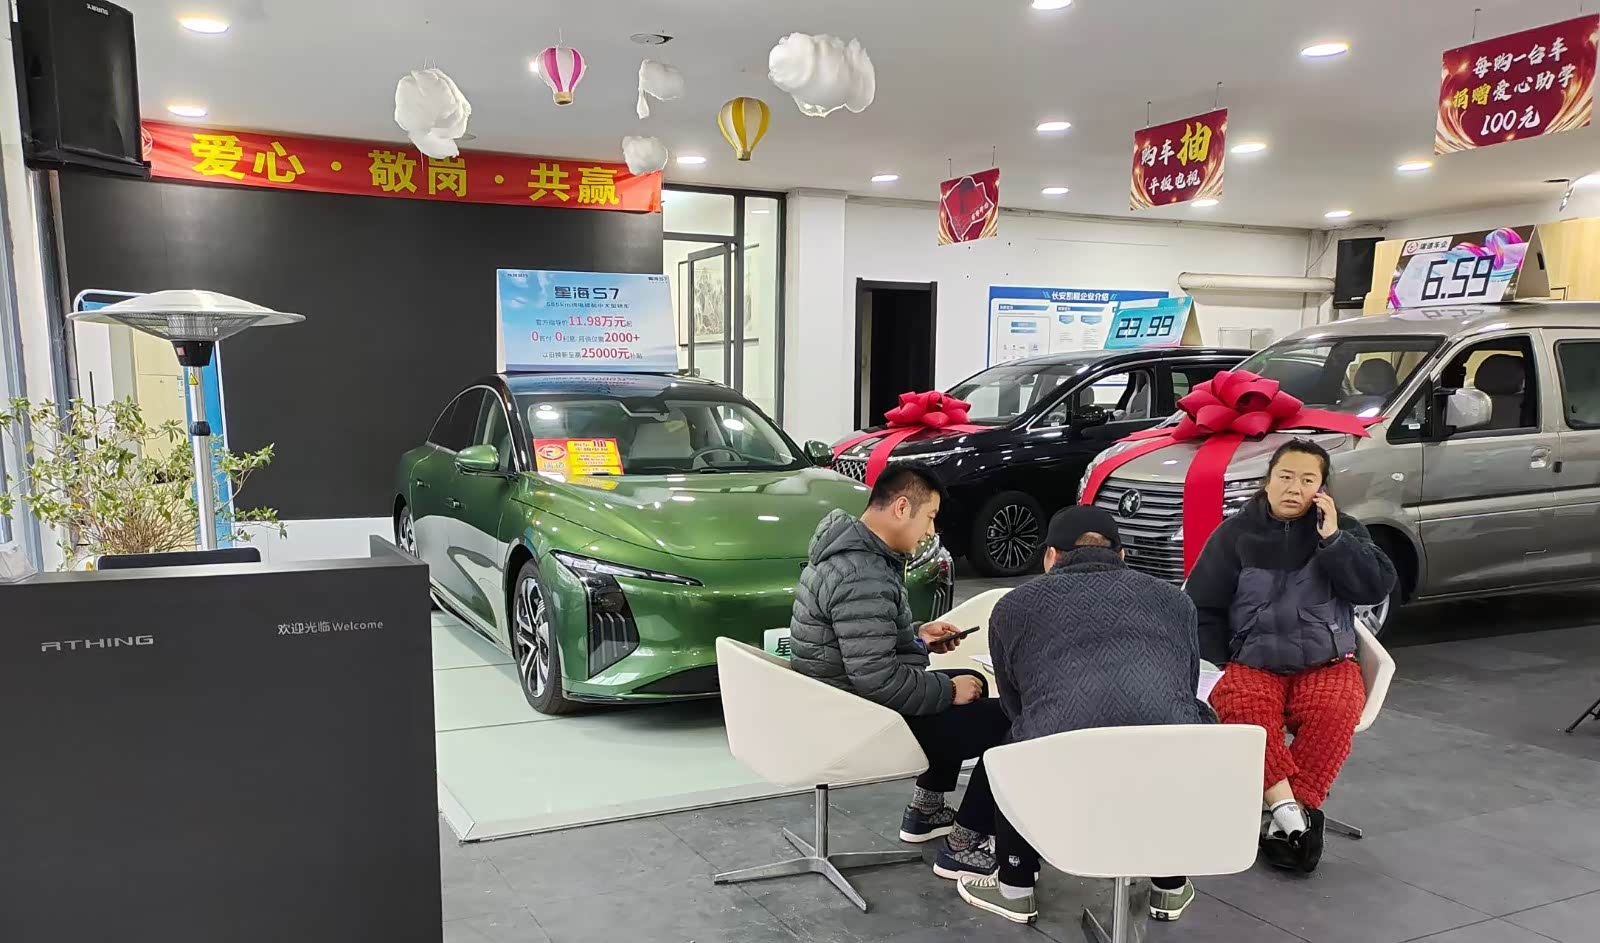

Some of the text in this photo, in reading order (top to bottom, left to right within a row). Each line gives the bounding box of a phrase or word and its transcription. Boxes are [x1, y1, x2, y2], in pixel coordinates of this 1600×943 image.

[1473, 36, 1568, 79] 每购一台车
[1452, 63, 1577, 110] 捐赠爱心助学
[1480, 104, 1541, 136] 100元
[1420, 254, 1497, 301] 6.59
[1115, 315, 1175, 339] 23.99
[277, 619, 384, 636] 欢迎光临 Welcome
